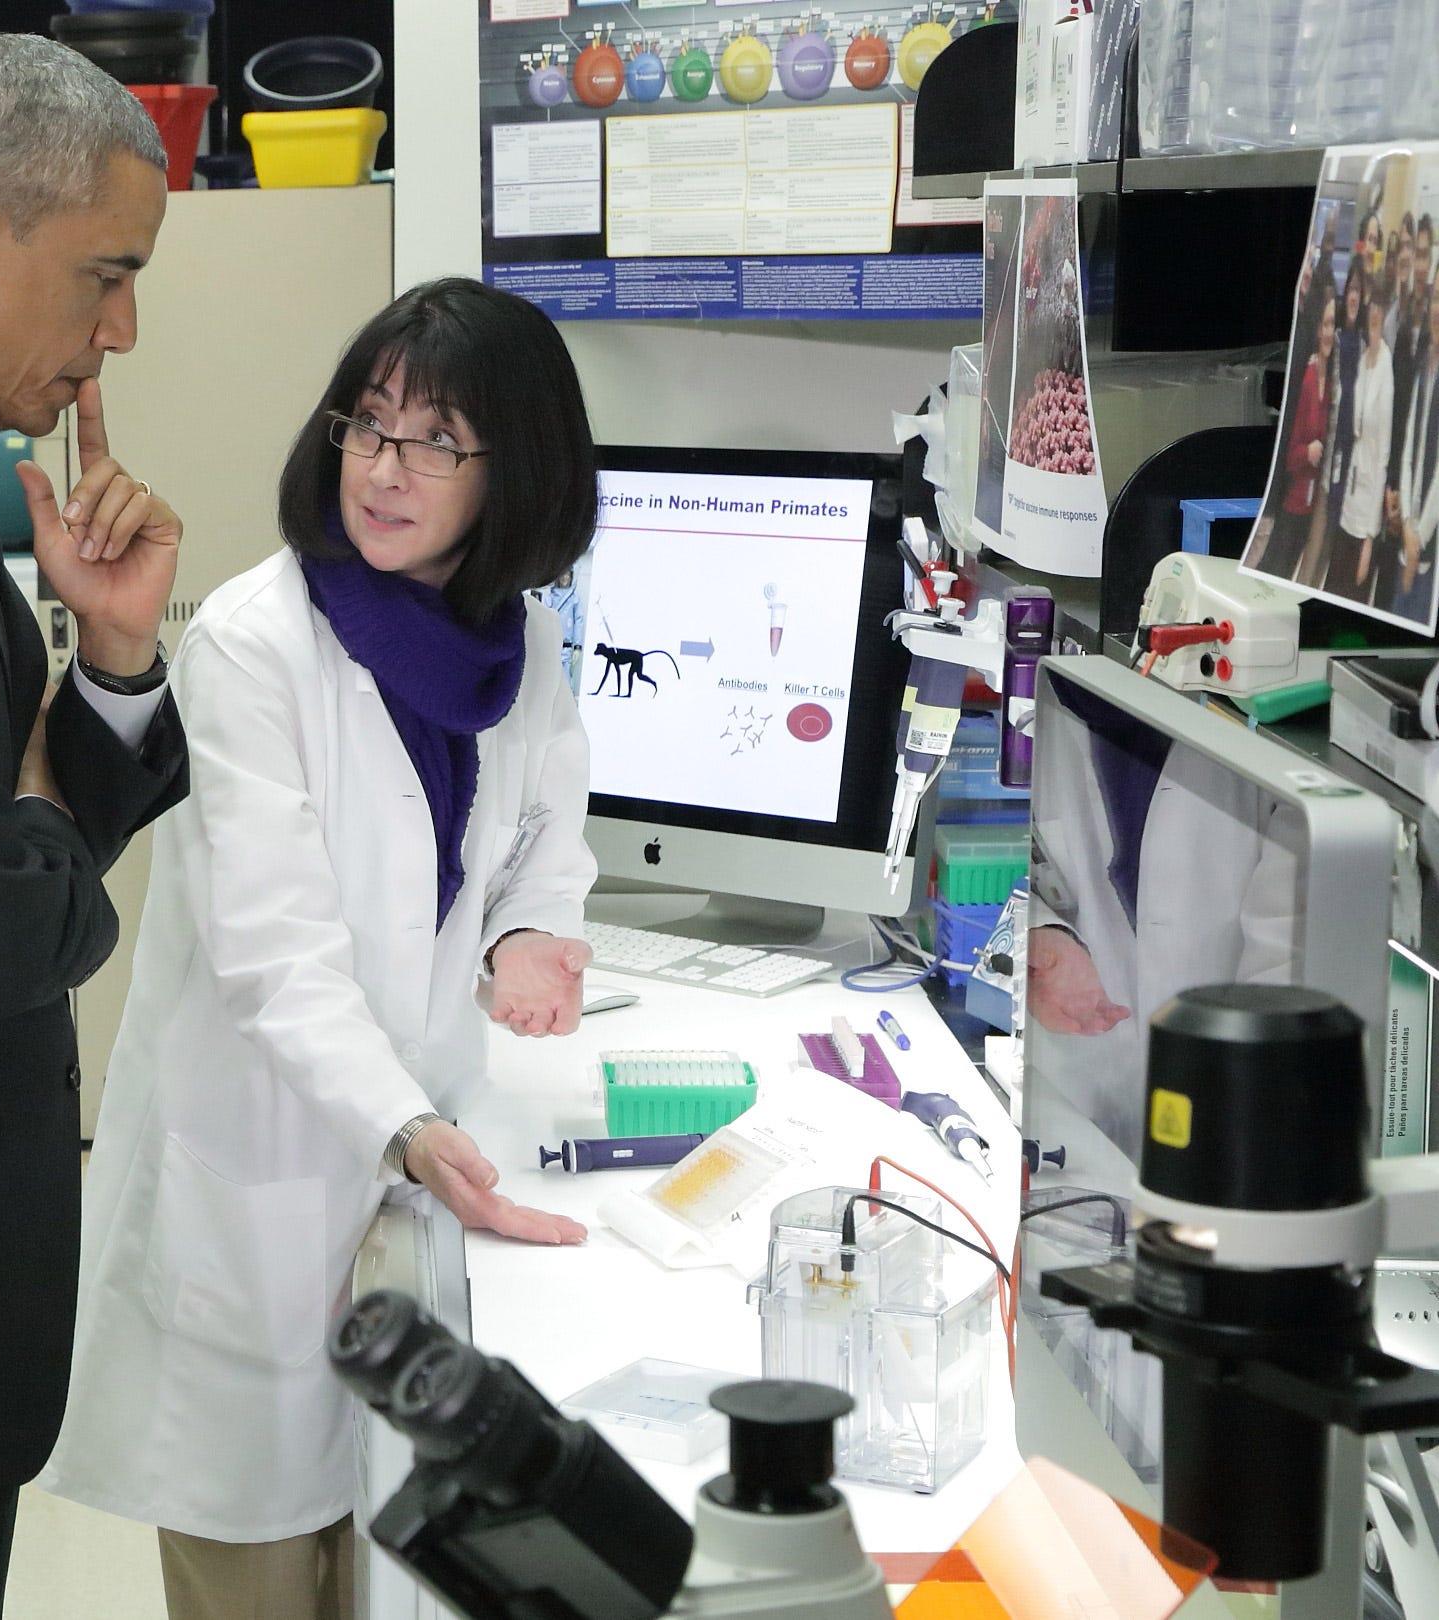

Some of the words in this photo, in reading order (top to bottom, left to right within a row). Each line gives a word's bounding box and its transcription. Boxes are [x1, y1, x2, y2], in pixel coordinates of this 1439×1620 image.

[599, 492, 643, 508] ccine
[648, 494, 663, 509] in
[668, 495, 765, 513] Non-Human
[770, 499, 849, 518] Primates
[1059, 509, 1098, 523] responses
[717, 677, 768, 692] Antibodies
[784, 682, 809, 694] Killer
[812, 685, 819, 695] T
[821, 686, 846, 698] Cells
[1400, 1027, 1410, 1065] delicadas
[1388, 1075, 1398, 1092] pour
[1400, 1067, 1409, 1092] tareas
[1400, 1093, 1409, 1111] para
[1386, 1094, 1396, 1138] Essuie-tout
